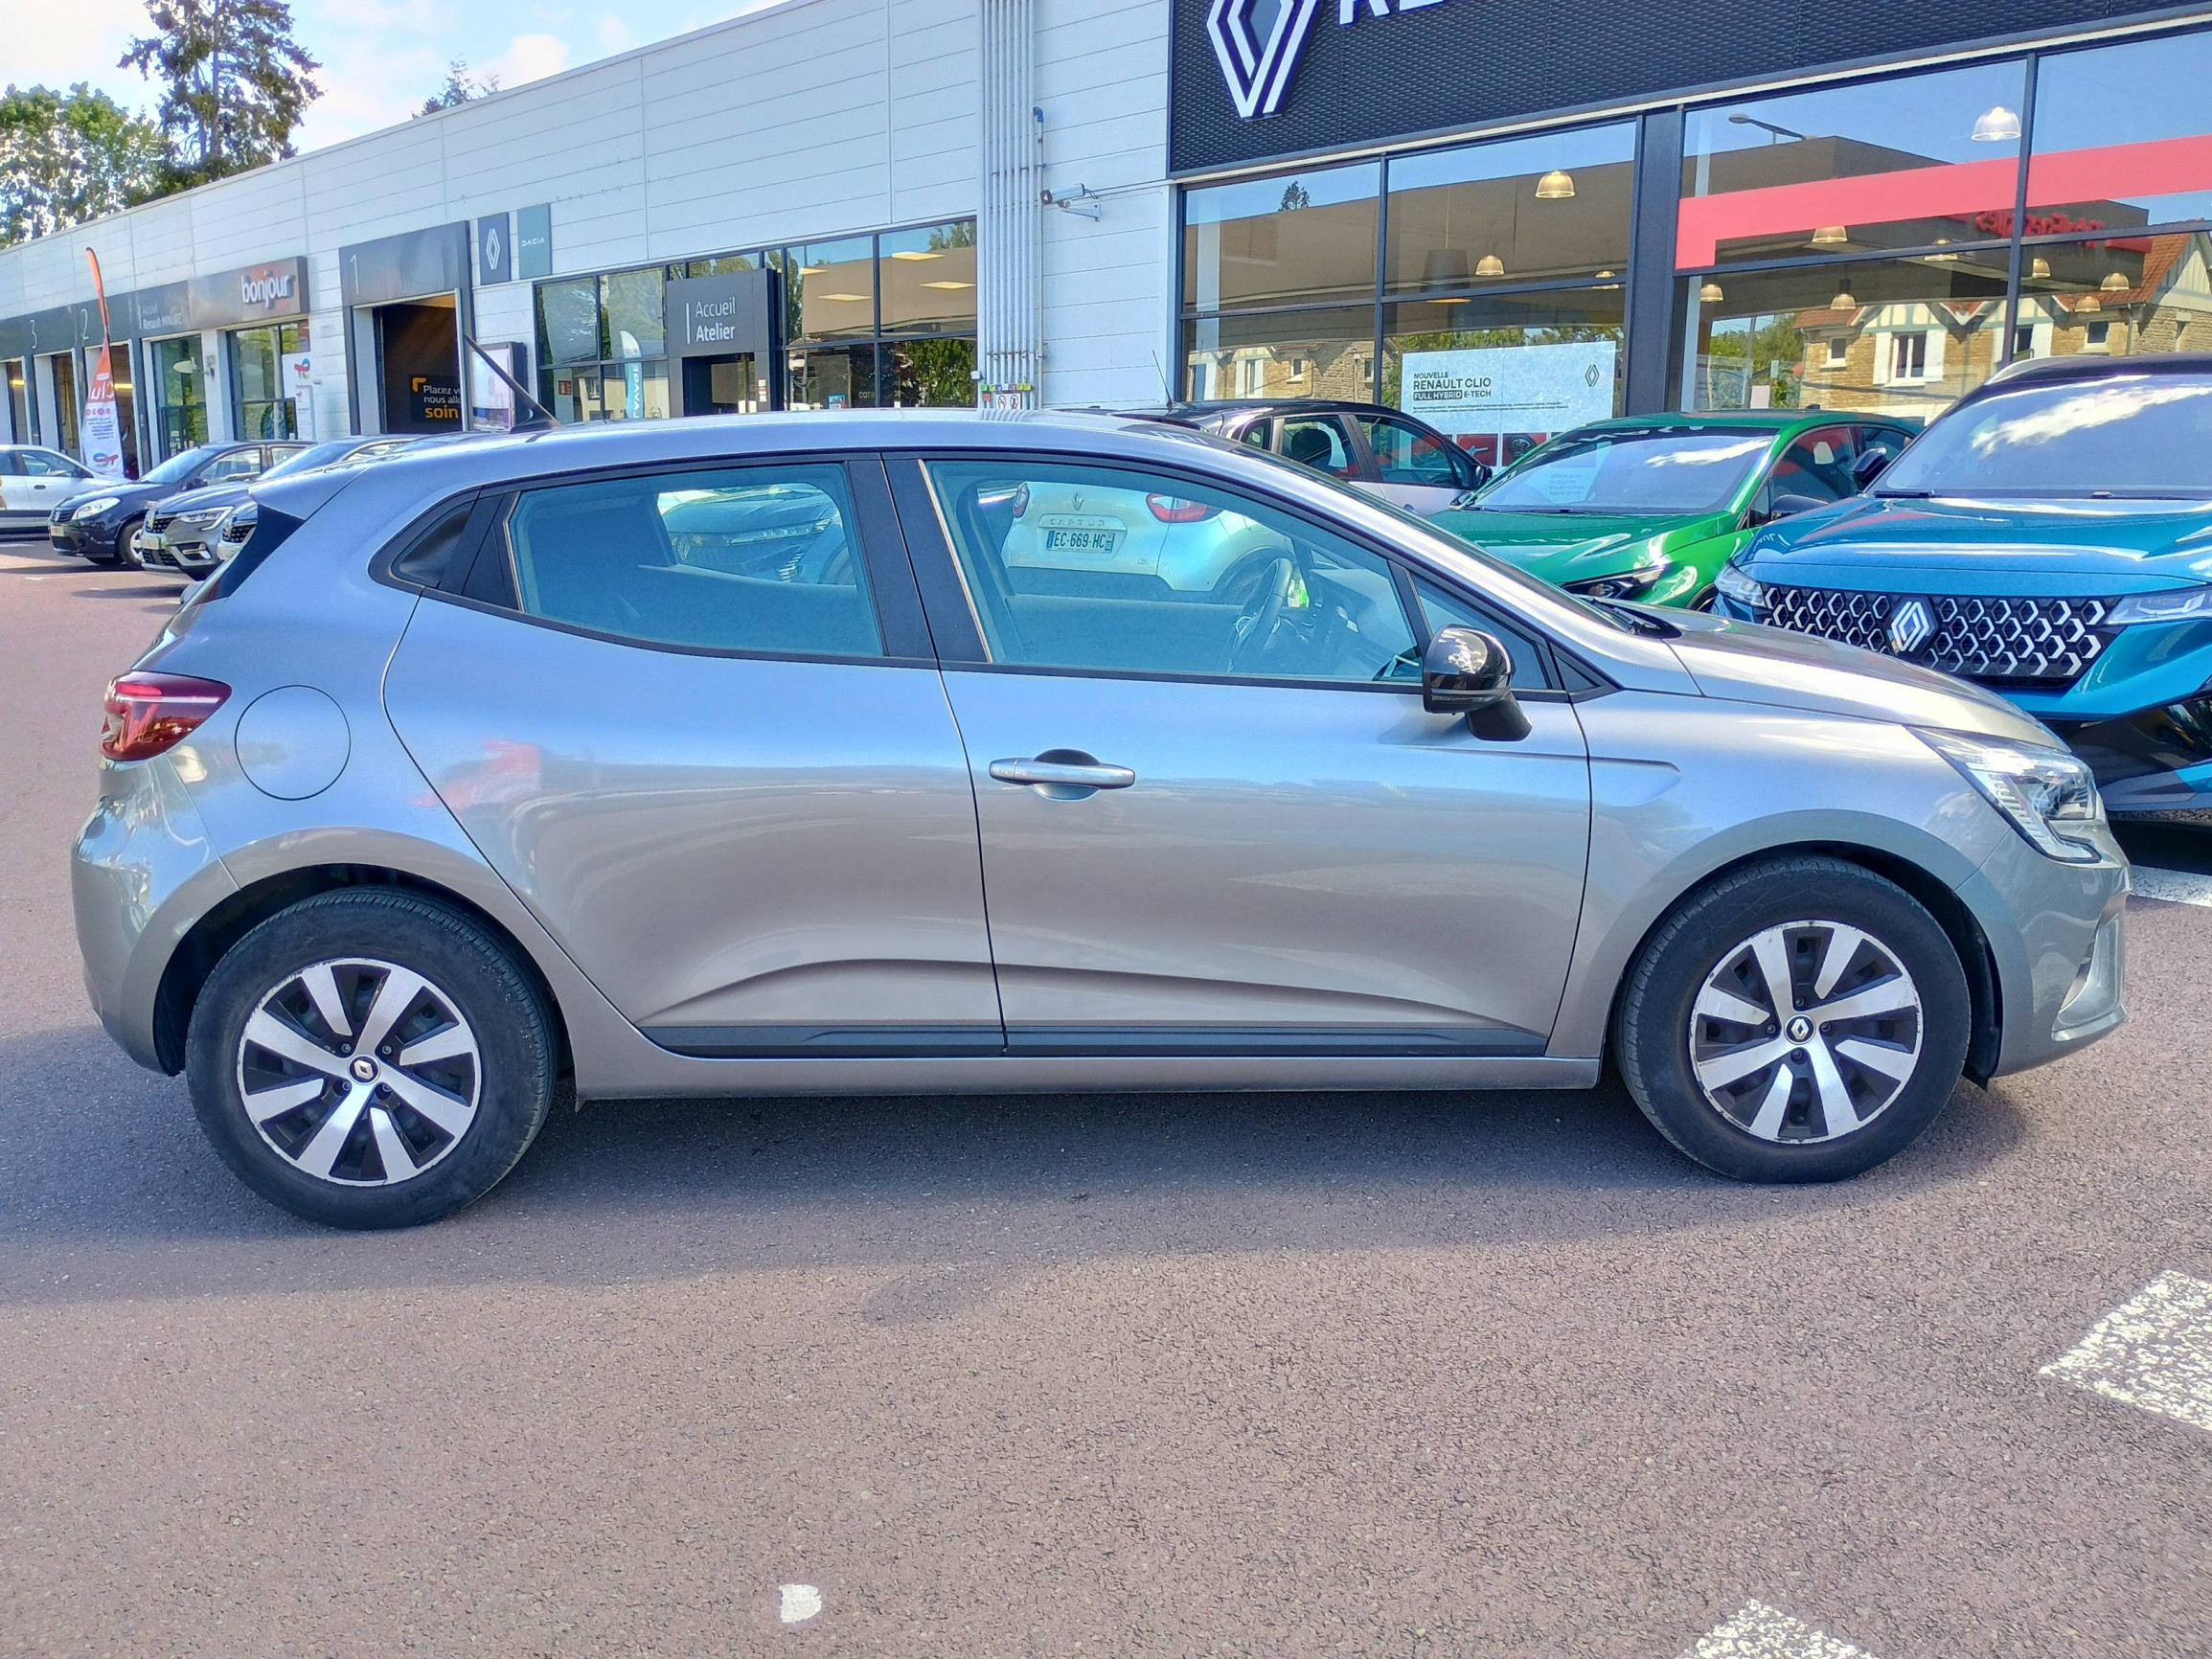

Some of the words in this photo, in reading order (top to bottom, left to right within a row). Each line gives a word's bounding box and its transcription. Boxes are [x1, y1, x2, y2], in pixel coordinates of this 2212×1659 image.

[521, 237, 545, 247] DACIA
[350, 254, 360, 296] 1
[240, 269, 289, 308] bonjour
[696, 296, 736, 318] Accueil
[80, 308, 90, 340] 2
[696, 322, 736, 342] Atelier
[30, 319, 37, 350] 3
[422, 385, 452, 394] Placez
[1413, 378, 1463, 391] RENAULT
[1465, 377, 1492, 388] CLIO
[1433, 391, 1462, 399] HYBRID
[424, 404, 459, 419] soin
[1050, 518, 1106, 527] CAPTUR
[1053, 532, 1106, 549] EC-669-HC
